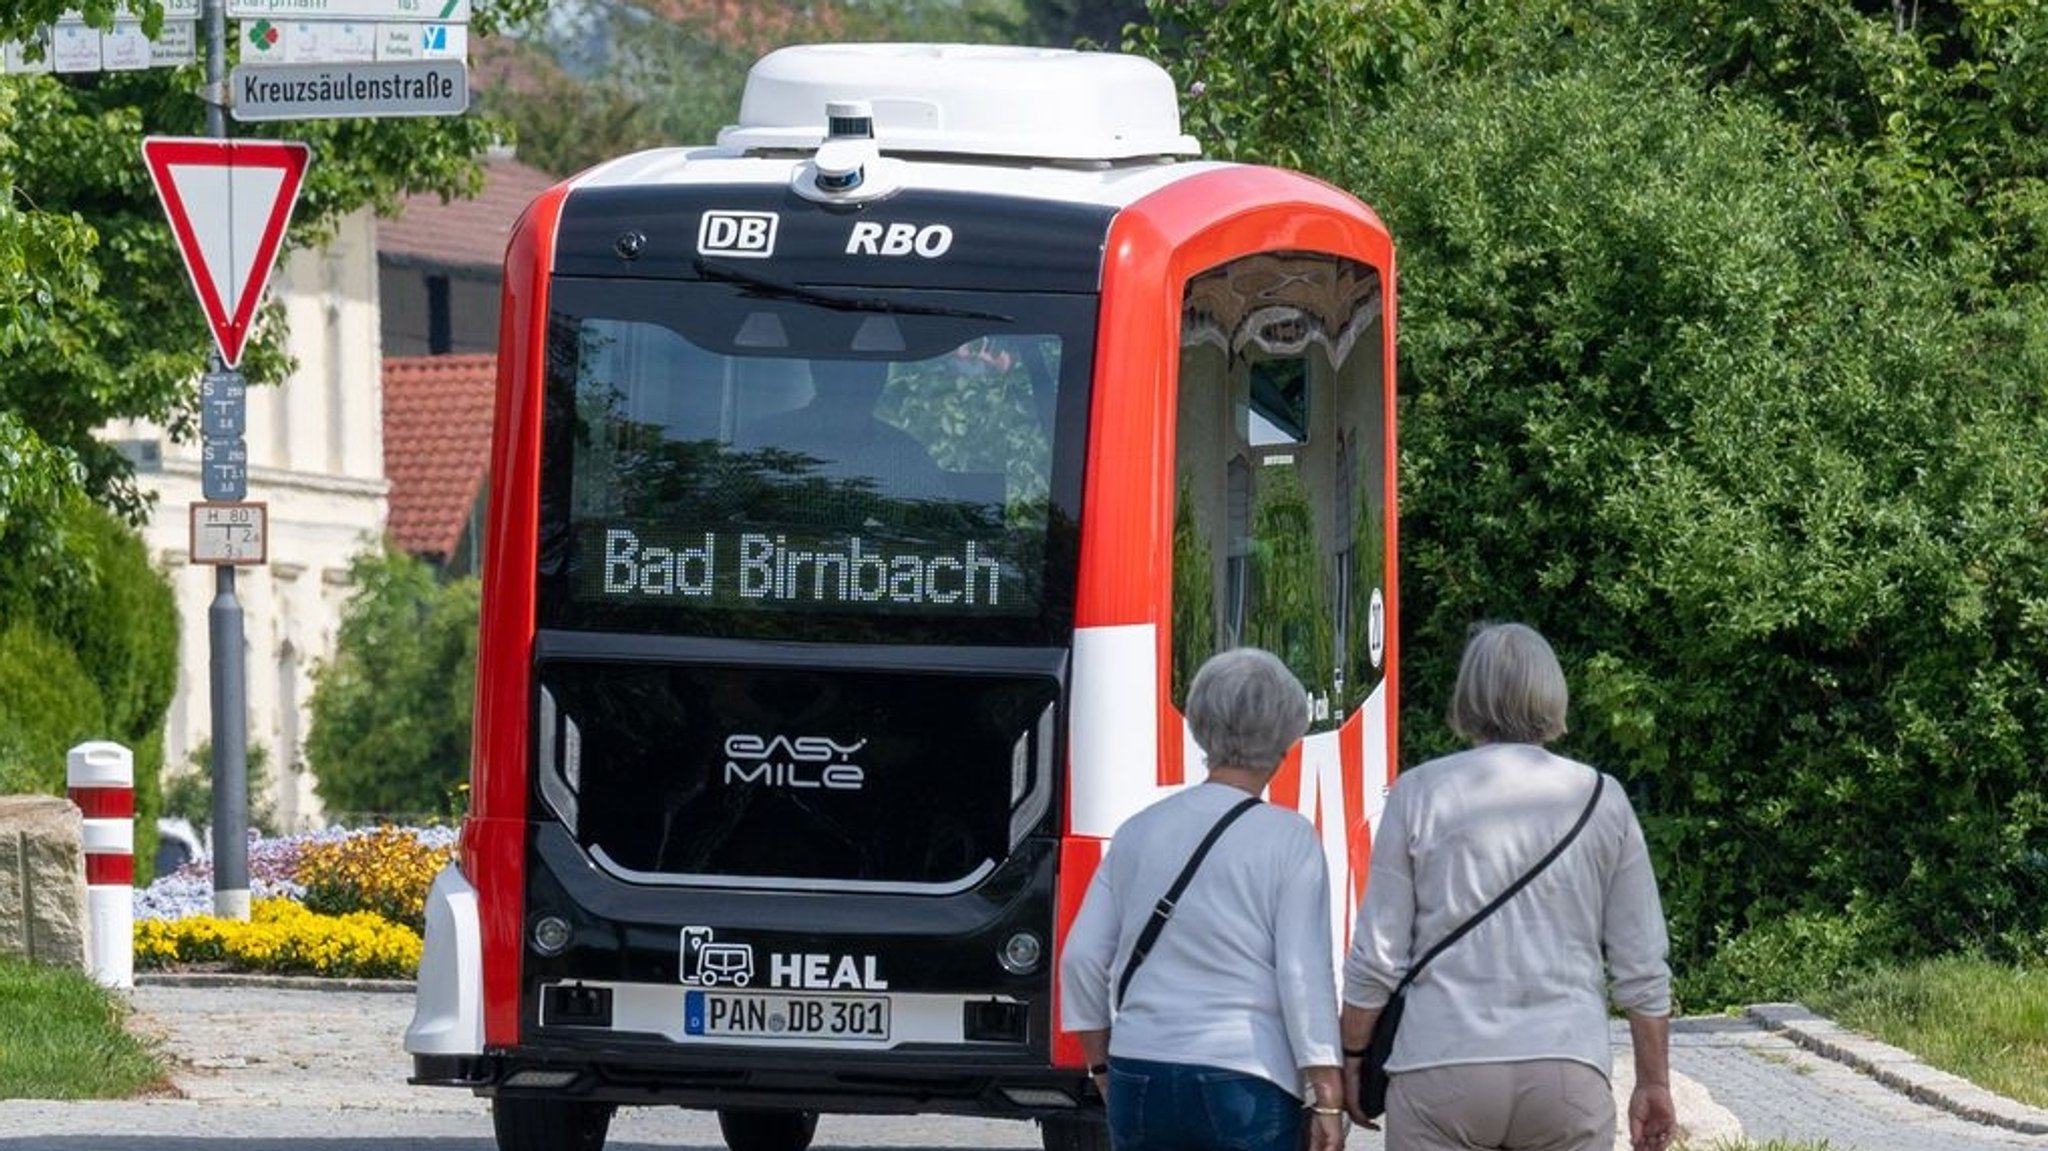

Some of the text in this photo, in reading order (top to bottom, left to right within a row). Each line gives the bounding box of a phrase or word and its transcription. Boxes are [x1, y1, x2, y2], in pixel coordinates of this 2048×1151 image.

[244, 73, 454, 104] Kreuzsäulenstraße
[707, 216, 768, 248] DB
[846, 221, 953, 257] RBO
[207, 509, 249, 522] H 80
[604, 529, 1000, 605] Bad Birnbach
[770, 953, 888, 990] HEAL
[709, 998, 884, 1035] PAN DB 301
